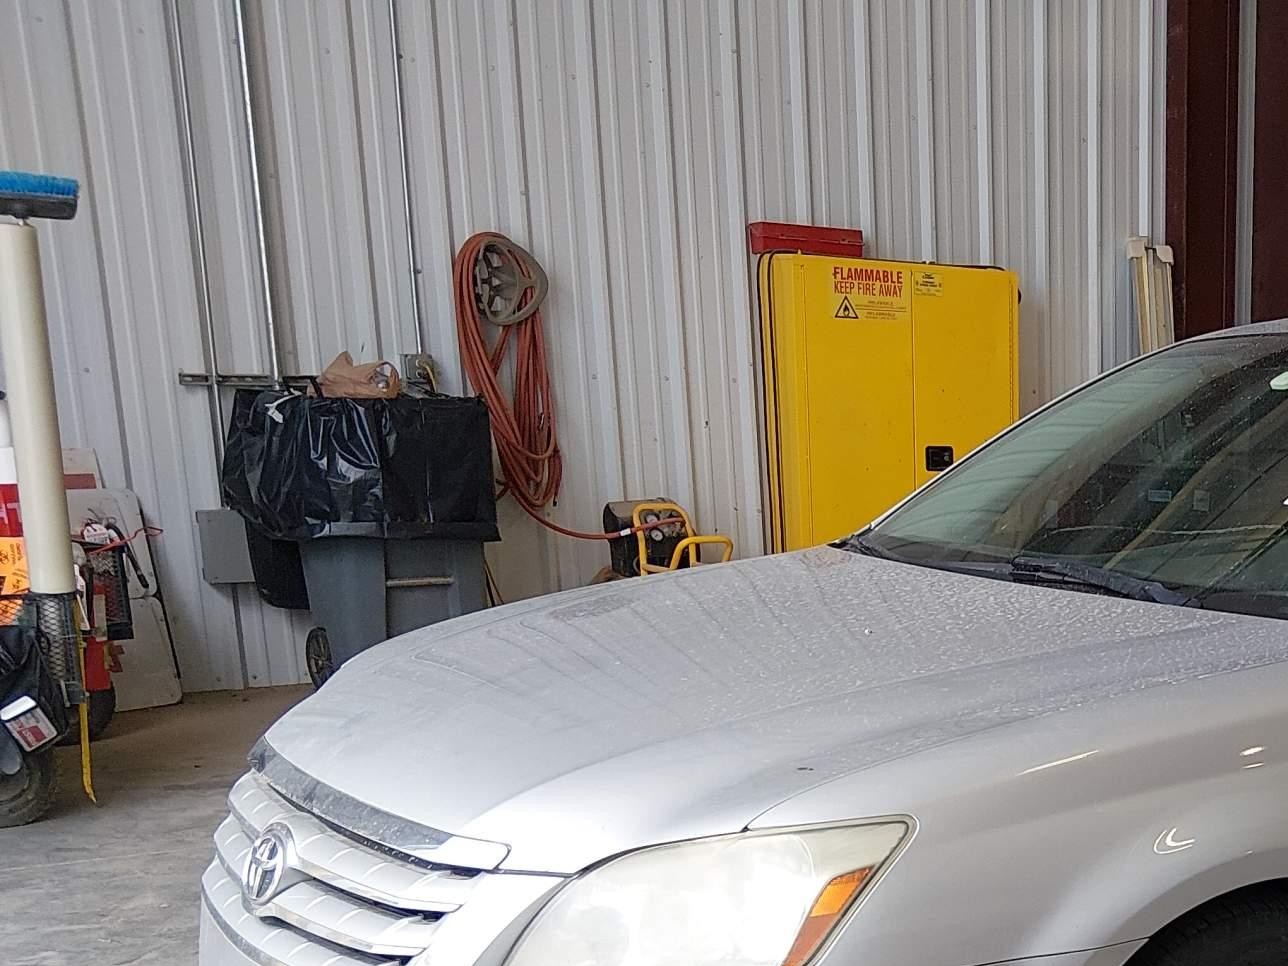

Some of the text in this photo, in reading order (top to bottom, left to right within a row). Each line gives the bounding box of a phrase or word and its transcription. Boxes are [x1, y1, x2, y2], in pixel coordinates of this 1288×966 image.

[833, 266, 903, 285] FLAMMABLE
[834, 281, 855, 295] KEEP
[857, 282, 877, 297] FIRE
[879, 284, 904, 299] AWAY
